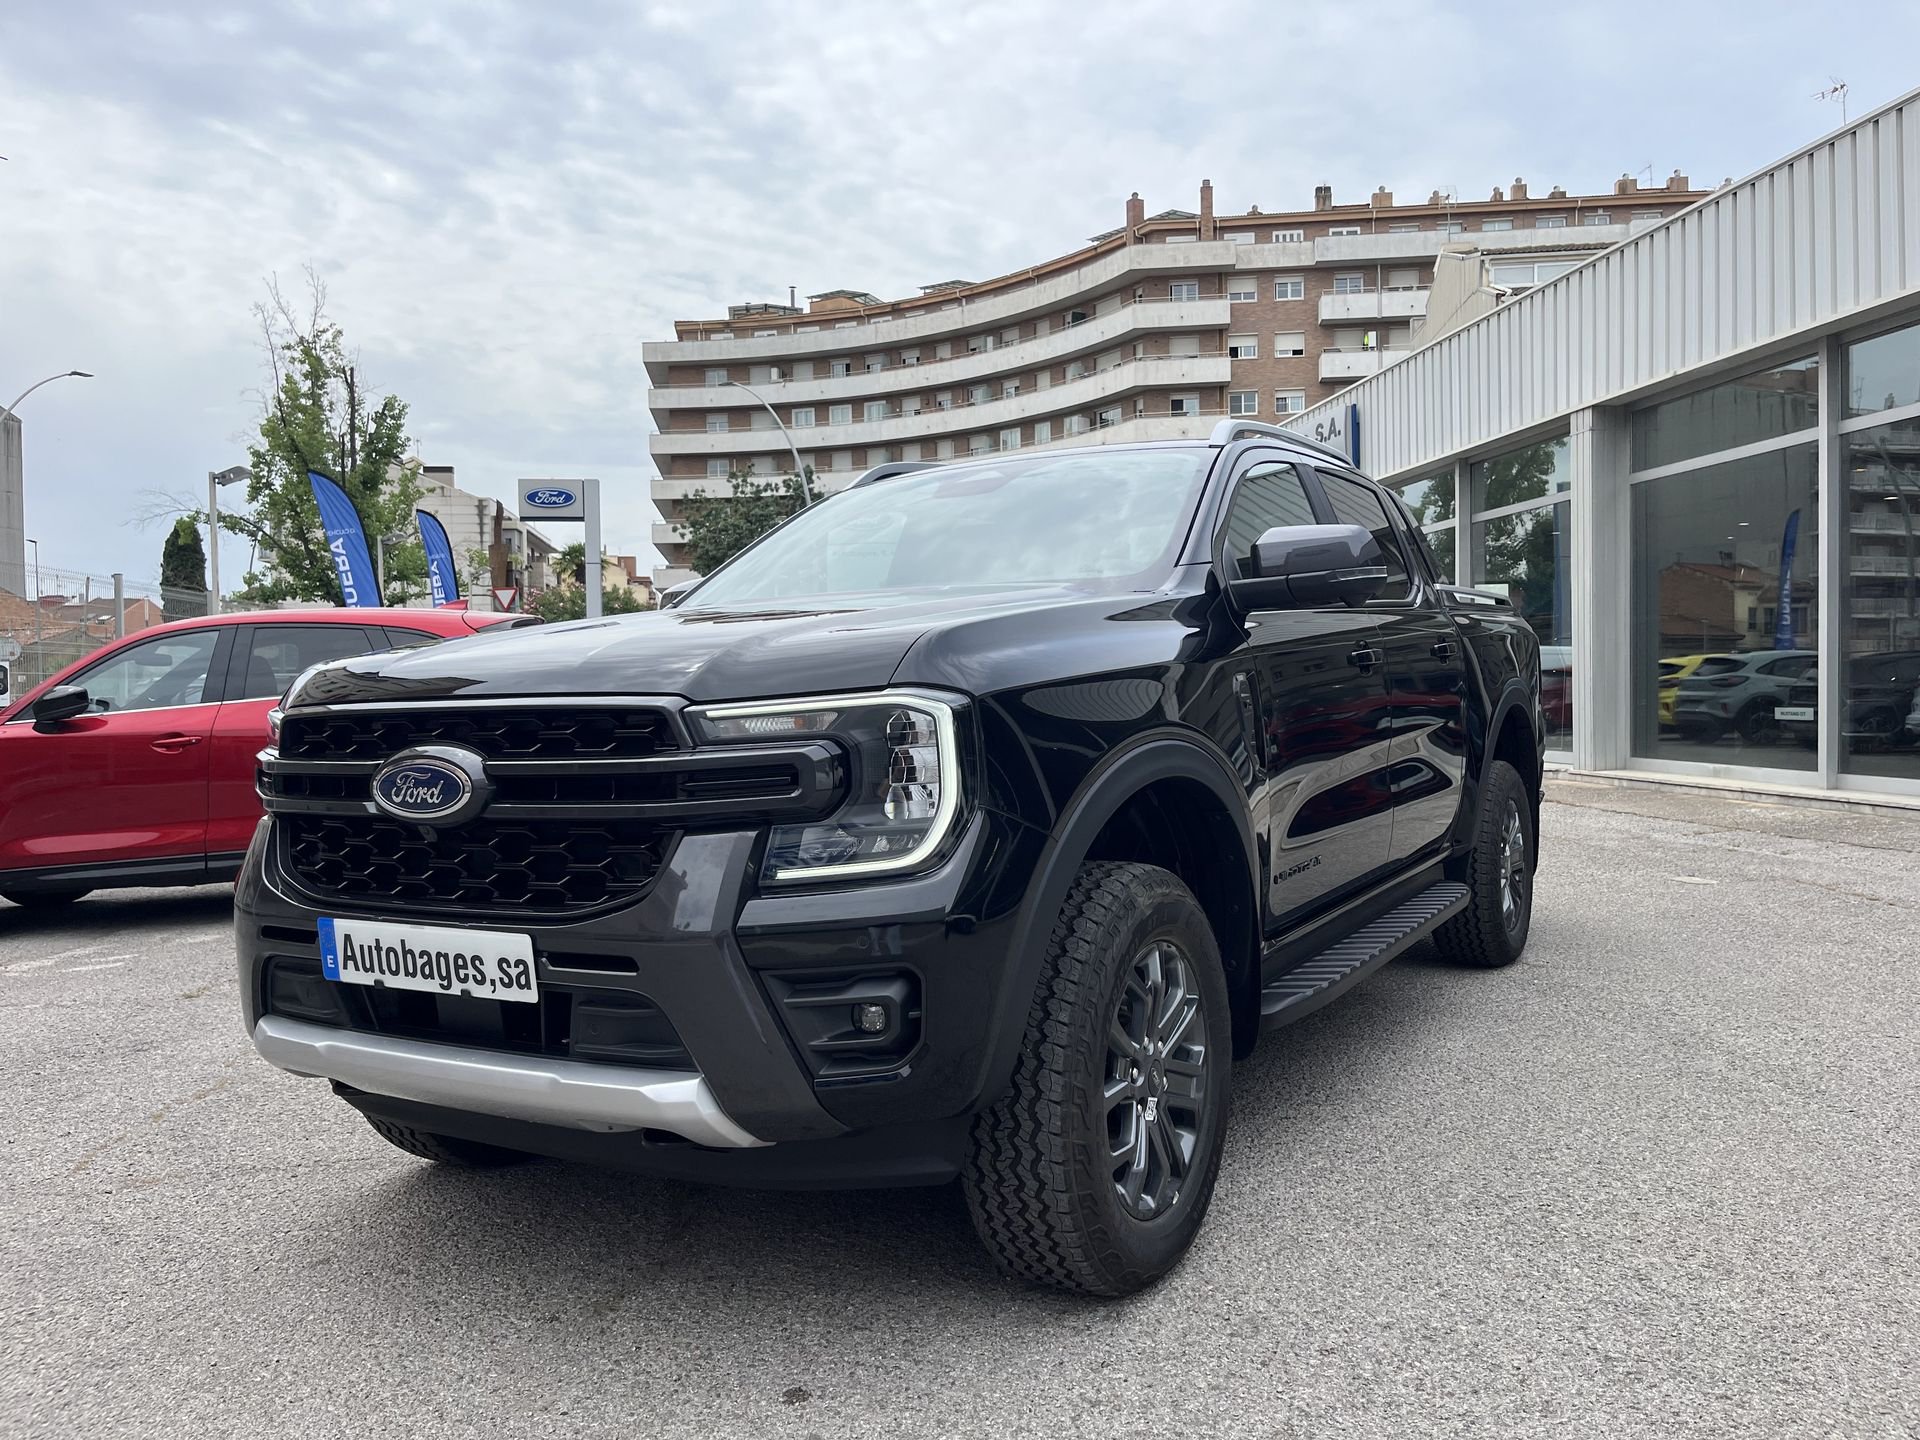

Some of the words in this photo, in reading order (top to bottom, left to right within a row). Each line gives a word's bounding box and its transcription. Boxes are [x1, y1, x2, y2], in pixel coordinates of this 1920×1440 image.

[535, 490, 566, 504] Ford
[391, 771, 444, 804] Ford
[327, 954, 335, 968] E
[342, 933, 533, 994] Autobages,sa
